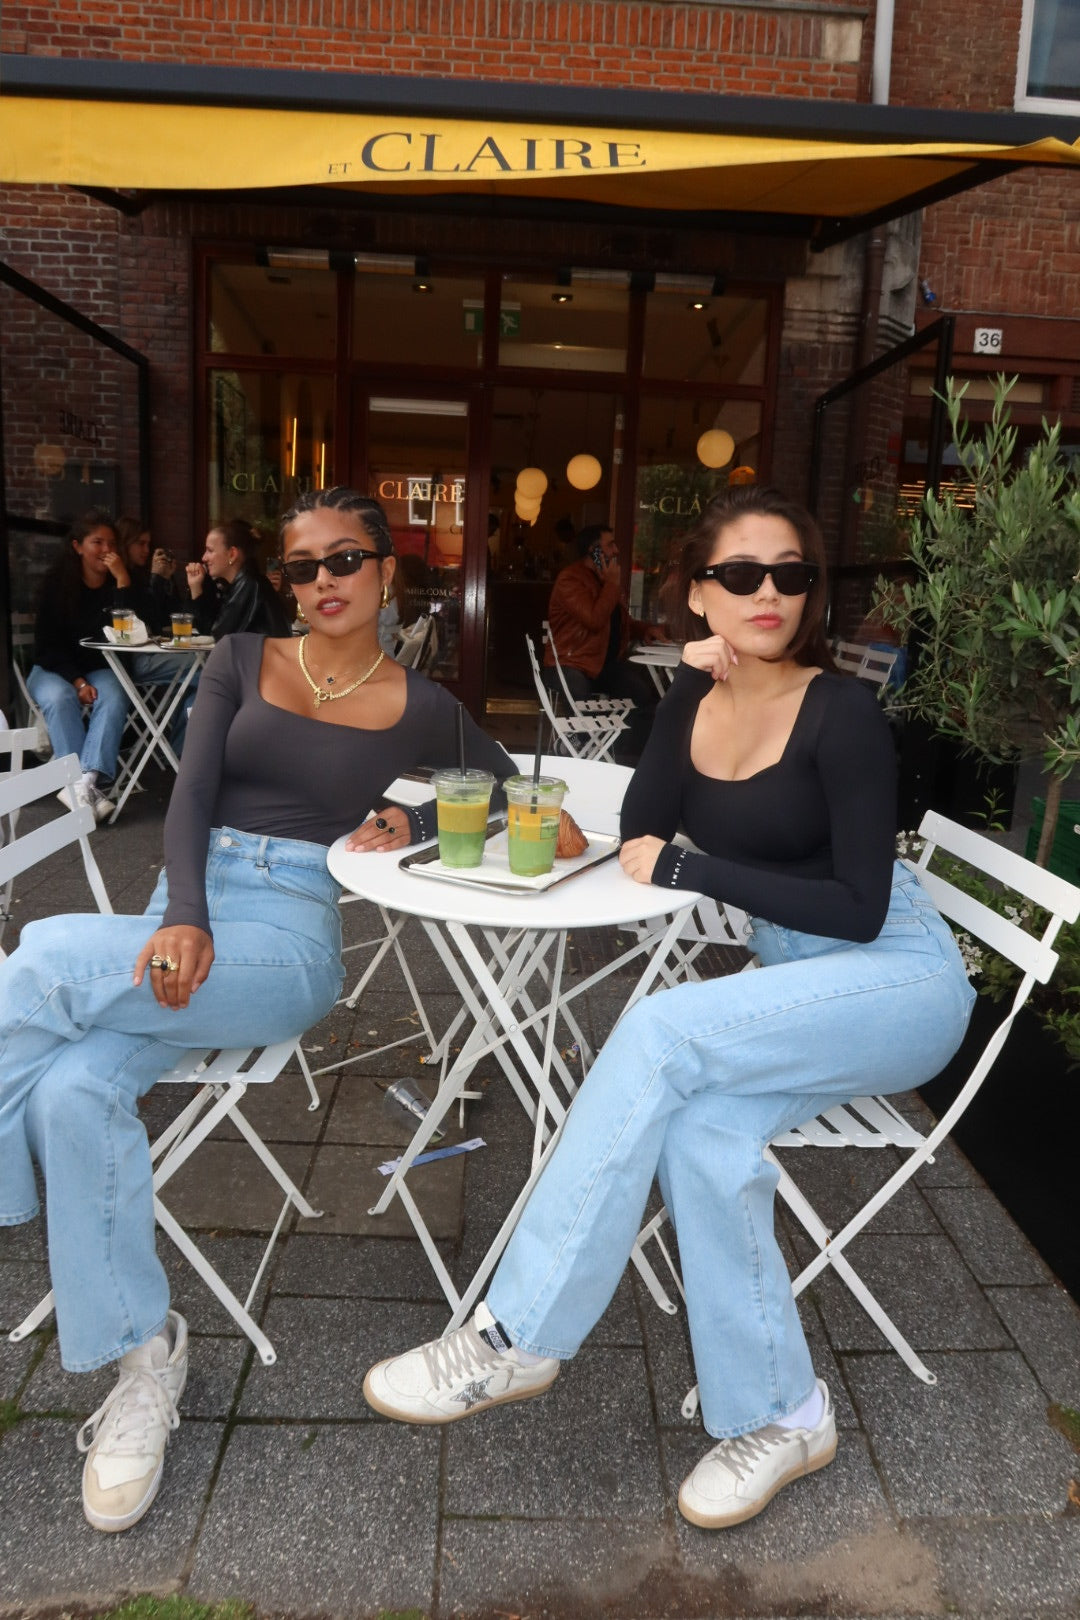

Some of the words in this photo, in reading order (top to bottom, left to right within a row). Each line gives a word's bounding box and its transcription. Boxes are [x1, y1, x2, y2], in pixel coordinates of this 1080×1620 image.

[328, 162, 353, 174] ET
[361, 132, 647, 173] CLAIRE
[979, 332, 1001, 347] 36
[378, 480, 463, 503] CLAIRE
